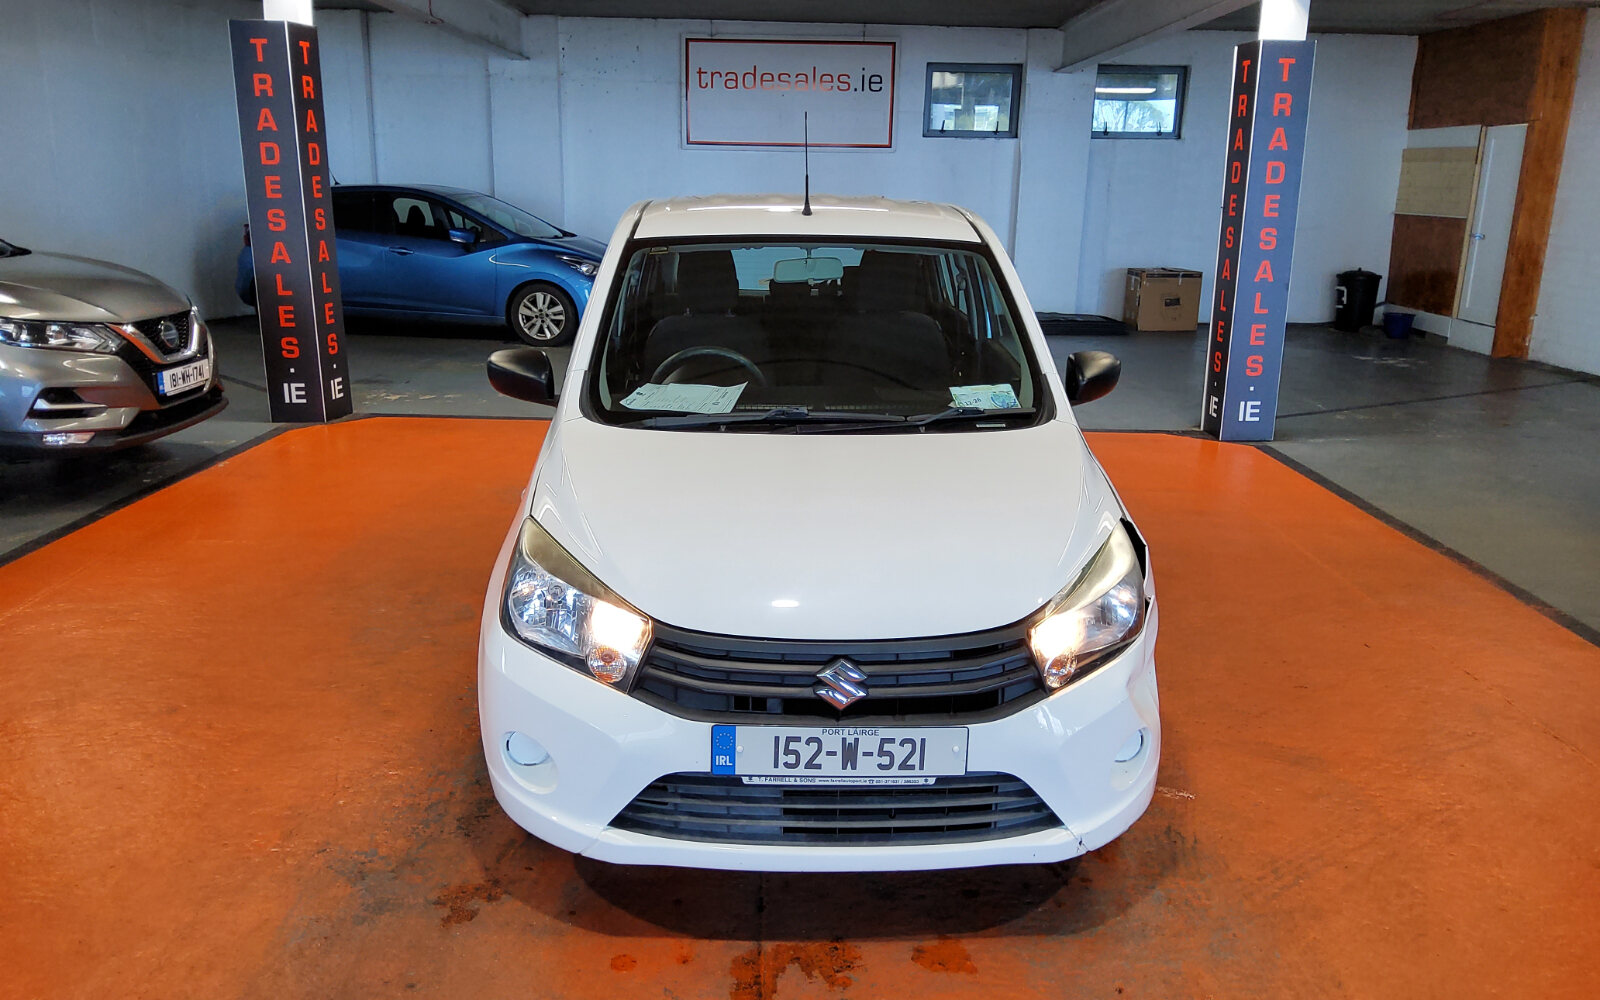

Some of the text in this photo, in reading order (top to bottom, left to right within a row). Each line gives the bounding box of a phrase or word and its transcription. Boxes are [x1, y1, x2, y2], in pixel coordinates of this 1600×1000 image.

[696, 65, 883, 92] tradesales.ie
[821, 727, 880, 737] PORT LÁIRGE
[715, 755, 733, 767] IRL
[773, 735, 926, 771] 152-W-521
